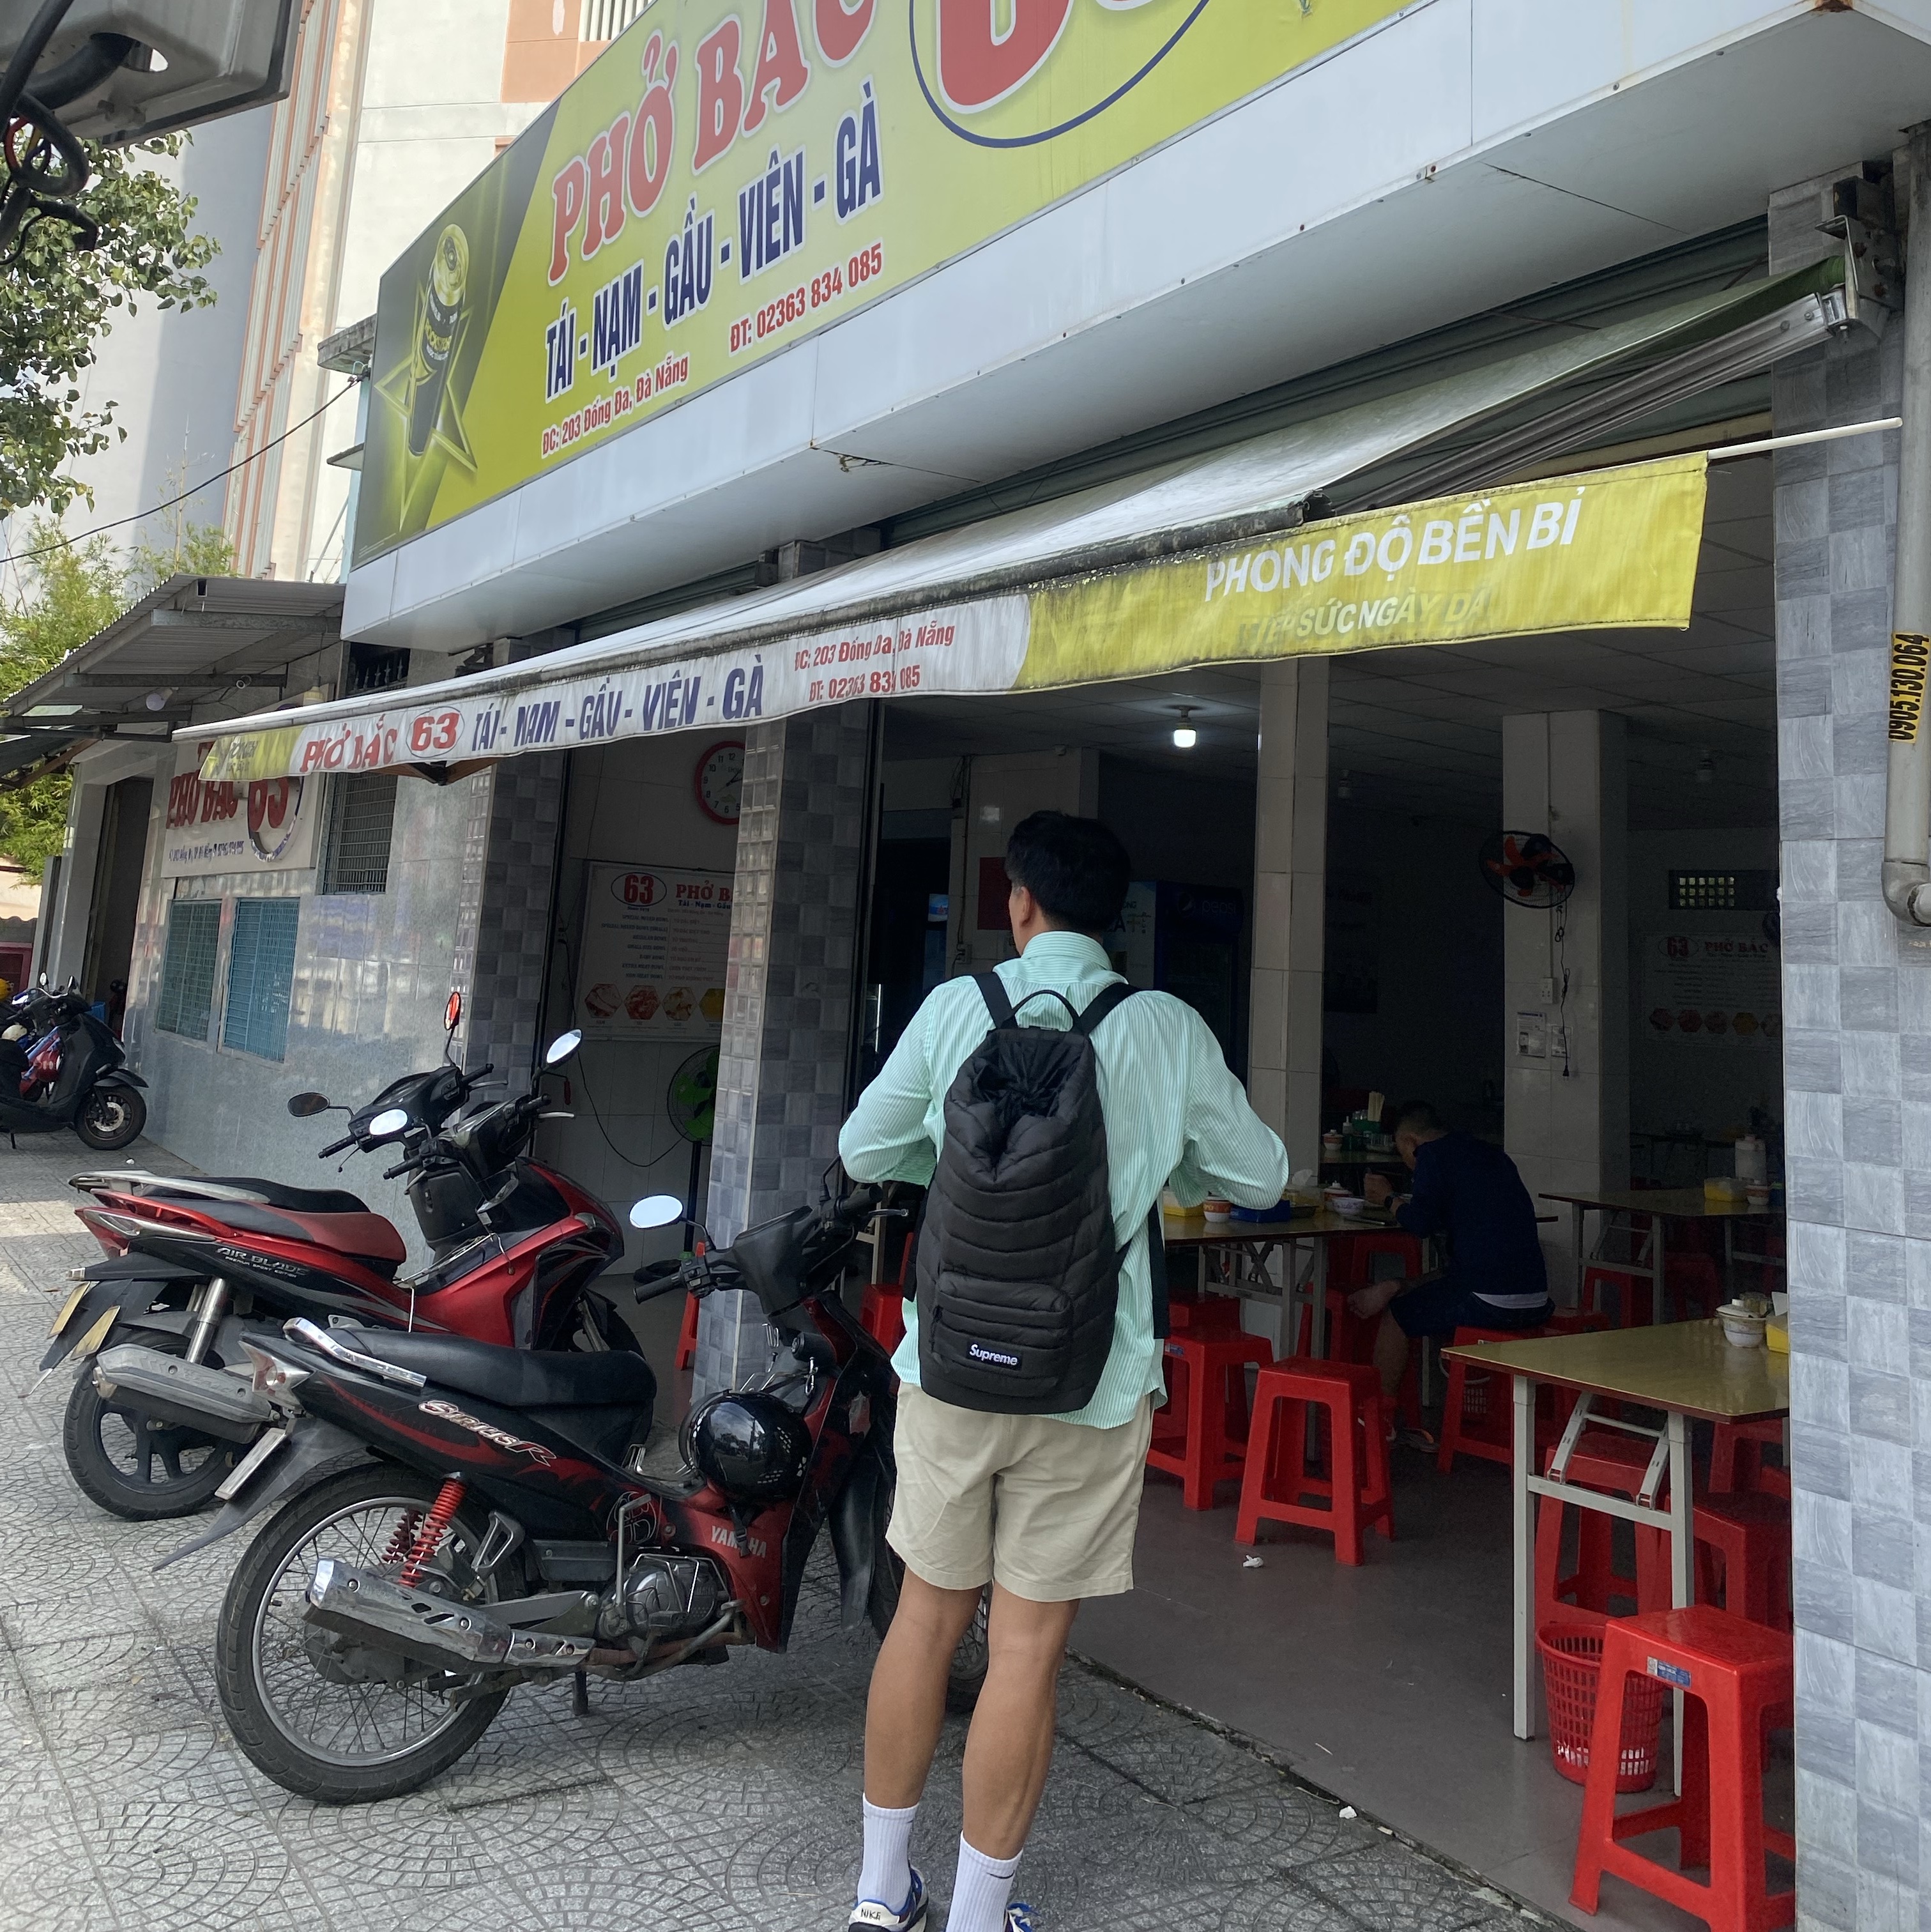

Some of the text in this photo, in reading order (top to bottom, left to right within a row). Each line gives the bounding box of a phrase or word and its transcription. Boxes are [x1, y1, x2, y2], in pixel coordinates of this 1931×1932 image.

[549, 31, 677, 282] PHỞ
[547, 303, 574, 397] TÁI
[593, 265, 642, 377] NẠM
[664, 197, 712, 325] GẦU
[738, 150, 804, 279] VIÊN
[836, 82, 882, 218] GÀ
[729, 243, 882, 353] ĐT: 02363 834 085
[542, 354, 689, 454] ĐC: 203 Đống Đa, Đà Nẵng
[1205, 485, 1584, 601] PHONG ĐỘ BỀN BỈ
[1297, 598, 1357, 636] SỨC
[1357, 587, 1437, 629] NGÀY
[813, 644, 837, 667] 203
[838, 636, 872, 662] Đống
[915, 620, 956, 648] Nẵng
[472, 703, 501, 751] TÁI
[643, 670, 701, 731] VIÊN
[722, 654, 763, 720] GÀ
[828, 673, 866, 700] 02363
[900, 665, 920, 690] 085
[1888, 634, 1930, 740] 0905.130.064
[300, 723, 351, 772] PHỞ
[347, 714, 397, 769] BẮC
[411, 712, 460, 751] 63
[623, 874, 655, 905] 63
[675, 880, 733, 902] PHỞ B
[1202, 900, 1237, 916] pepsi
[215, 1247, 310, 1276] AIR BLADE
[252, 1263, 272, 1271] SPORT
[969, 1344, 1018, 1366] Supreme
[711, 1525, 767, 1559] YAMHA
[860, 1908, 882, 1921] NIKE
